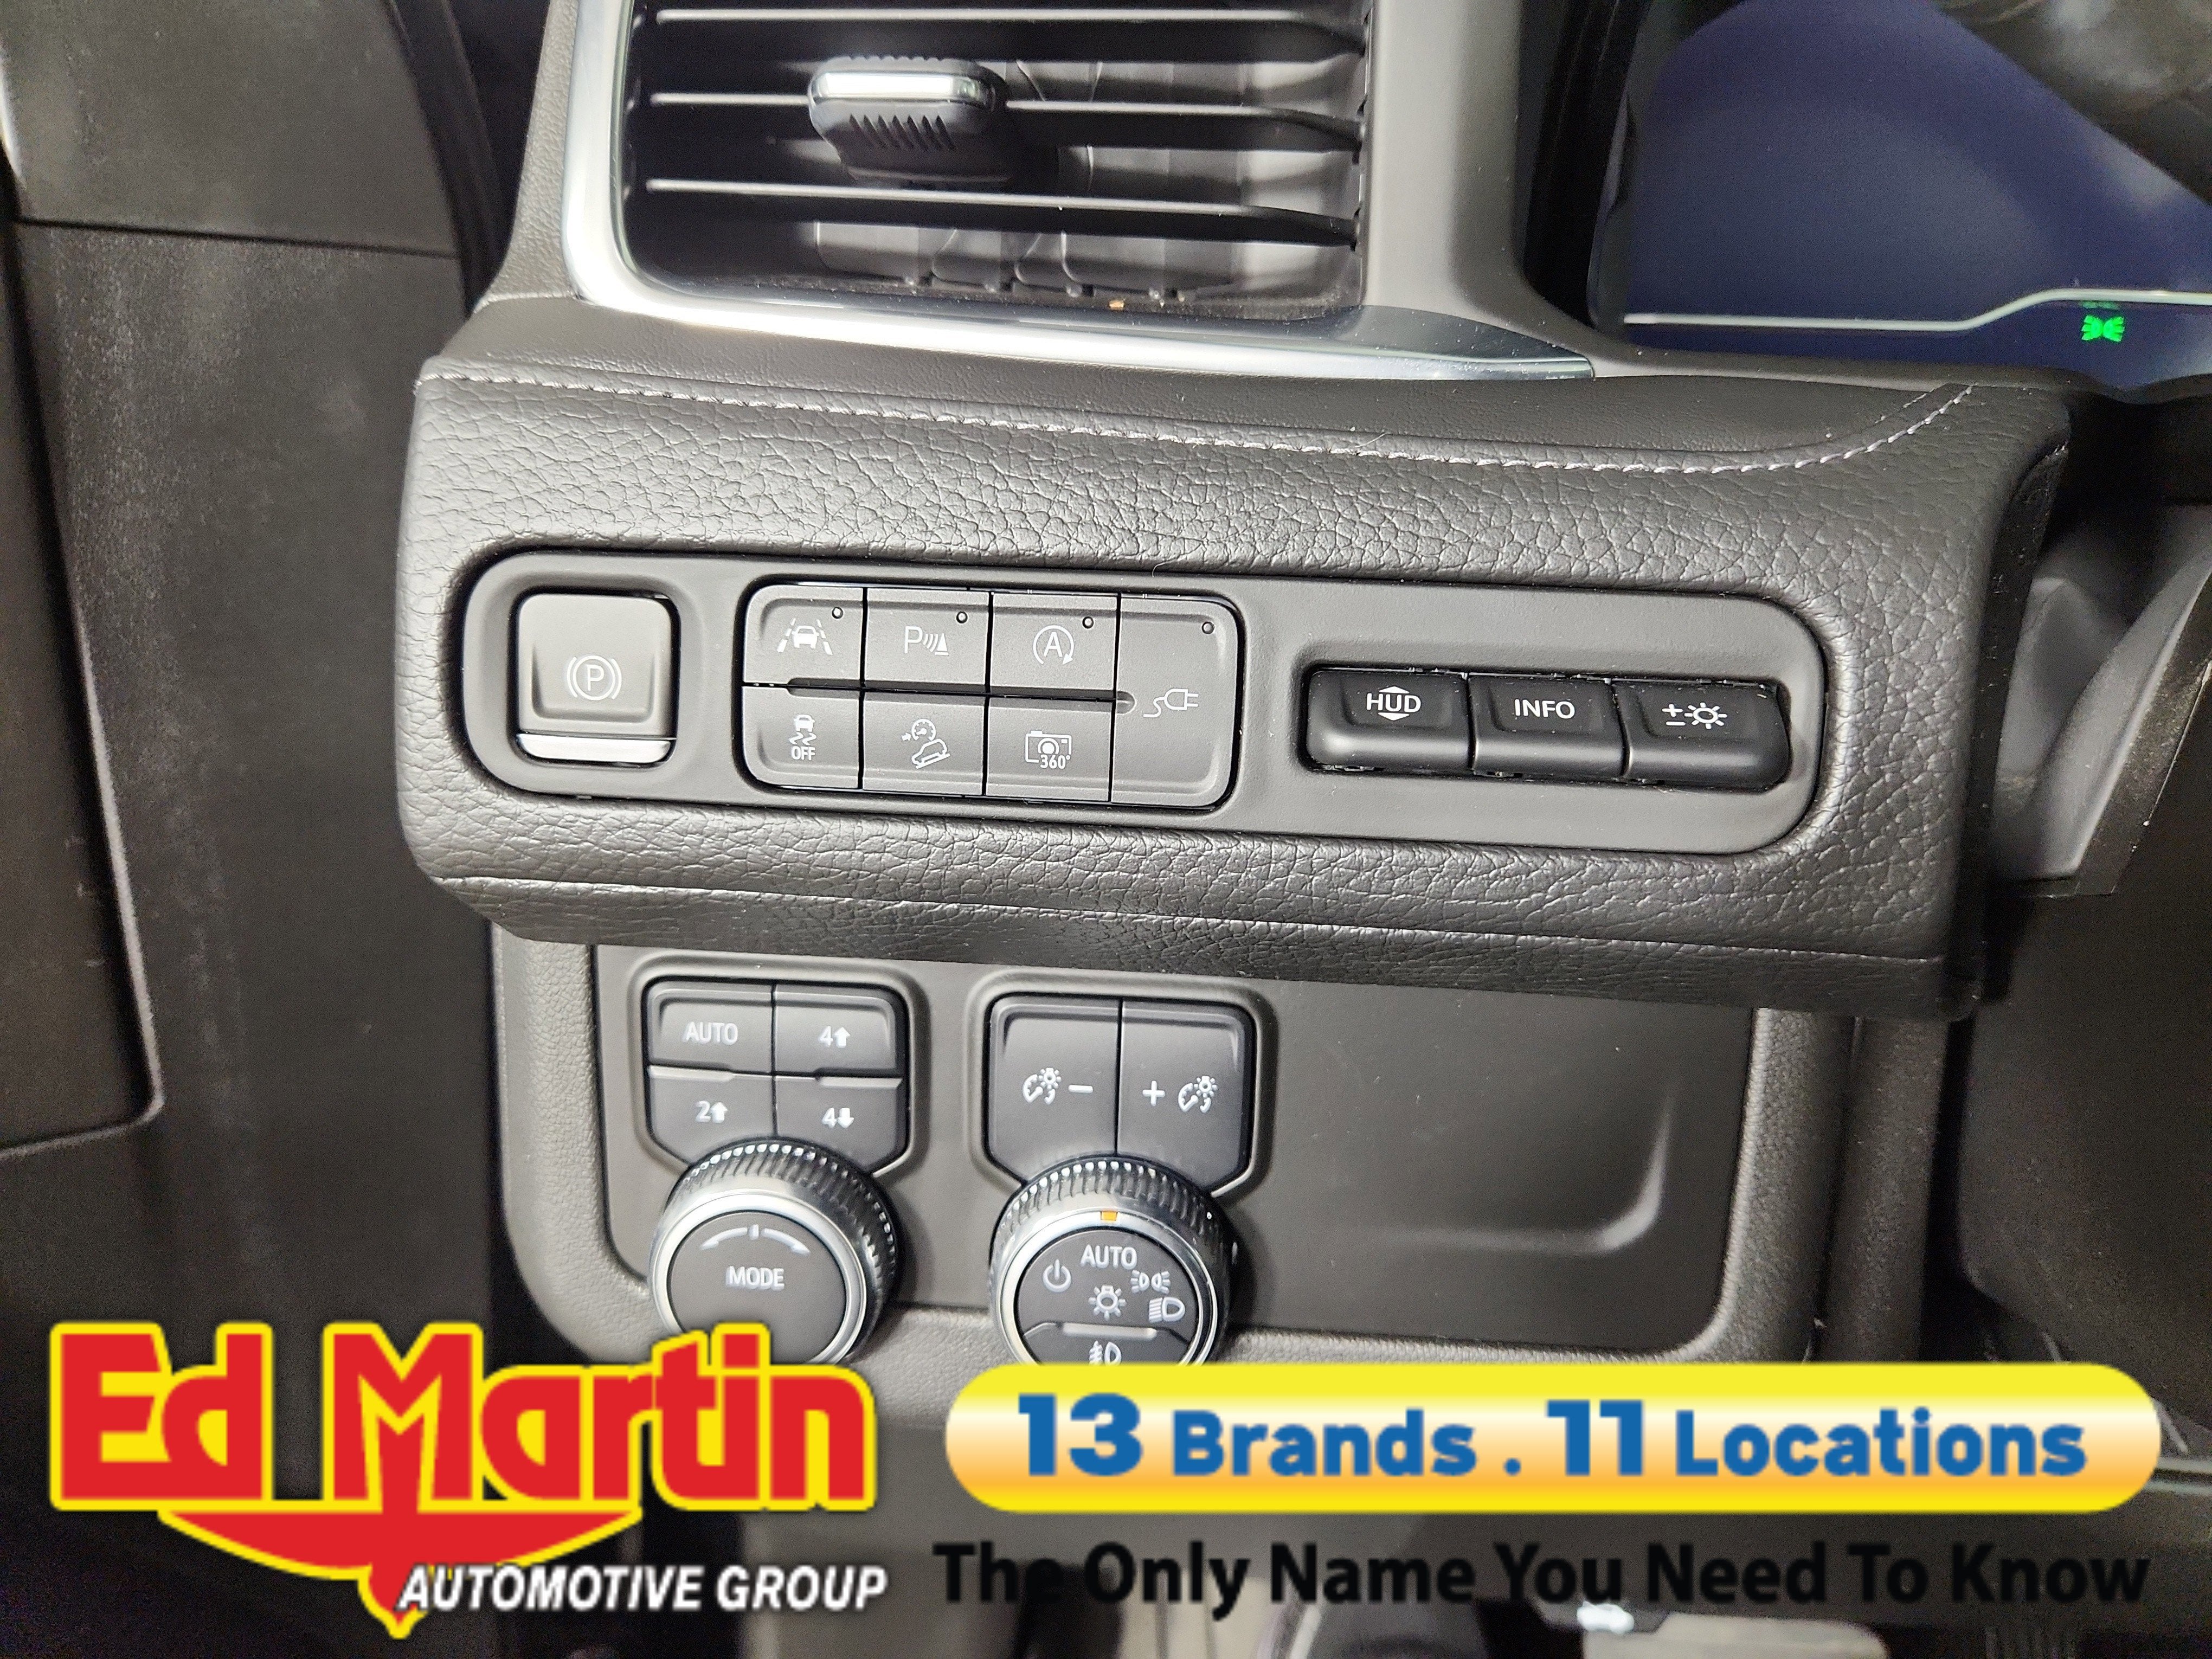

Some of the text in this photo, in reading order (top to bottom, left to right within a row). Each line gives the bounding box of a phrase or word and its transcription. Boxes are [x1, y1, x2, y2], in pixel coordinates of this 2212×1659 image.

[586, 665, 605, 691] P
[1366, 692, 1422, 715] HUD
[1514, 698, 1576, 719] INFO
[792, 746, 815, 761] OFF
[683, 1022, 738, 1045] AUTO
[818, 1026, 834, 1047] 4
[696, 1100, 711, 1122] 2
[822, 1108, 836, 1128] 4
[1081, 1244, 1137, 1270] AUTO
[726, 1265, 785, 1290] MODE
